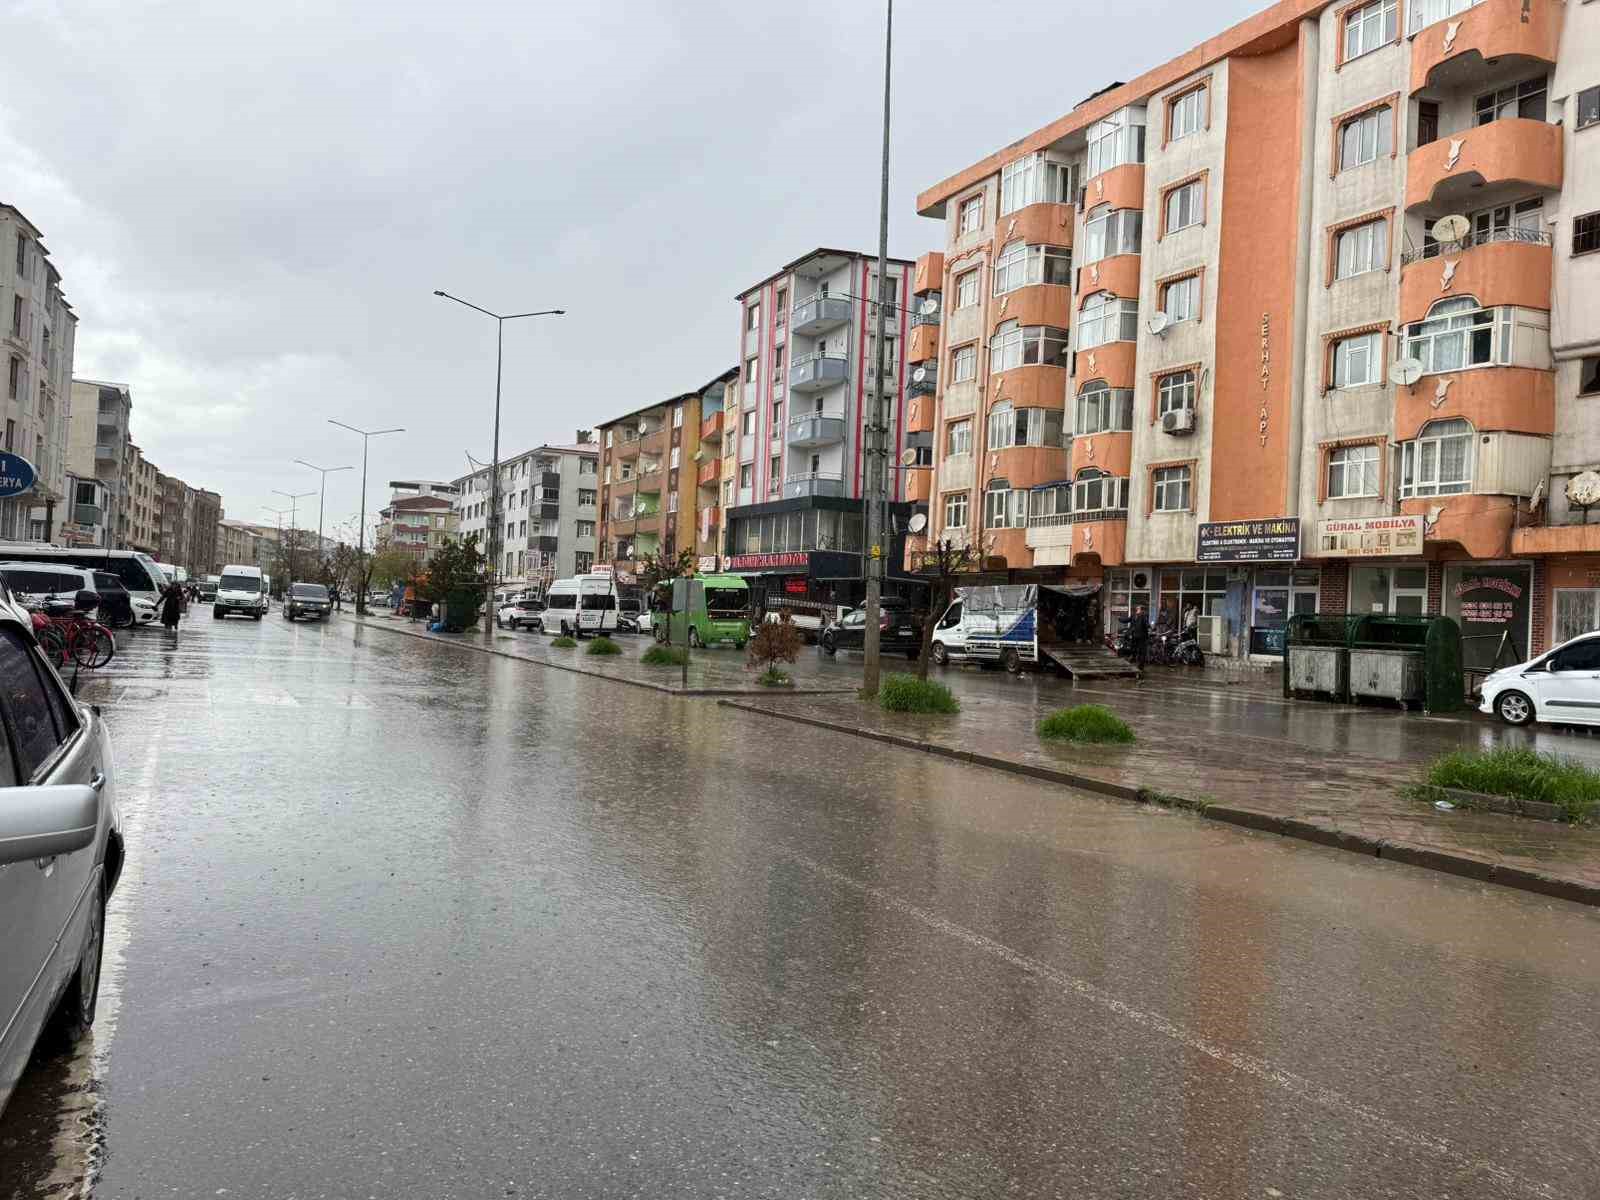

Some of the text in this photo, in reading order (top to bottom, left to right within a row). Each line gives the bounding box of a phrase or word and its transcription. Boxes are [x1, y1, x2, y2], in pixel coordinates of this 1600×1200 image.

[1260, 311, 1270, 391] SERHAT
[1252, 523, 1264, 535] VE
[1326, 518, 1416, 532] GÜRAL MOBİLYA
